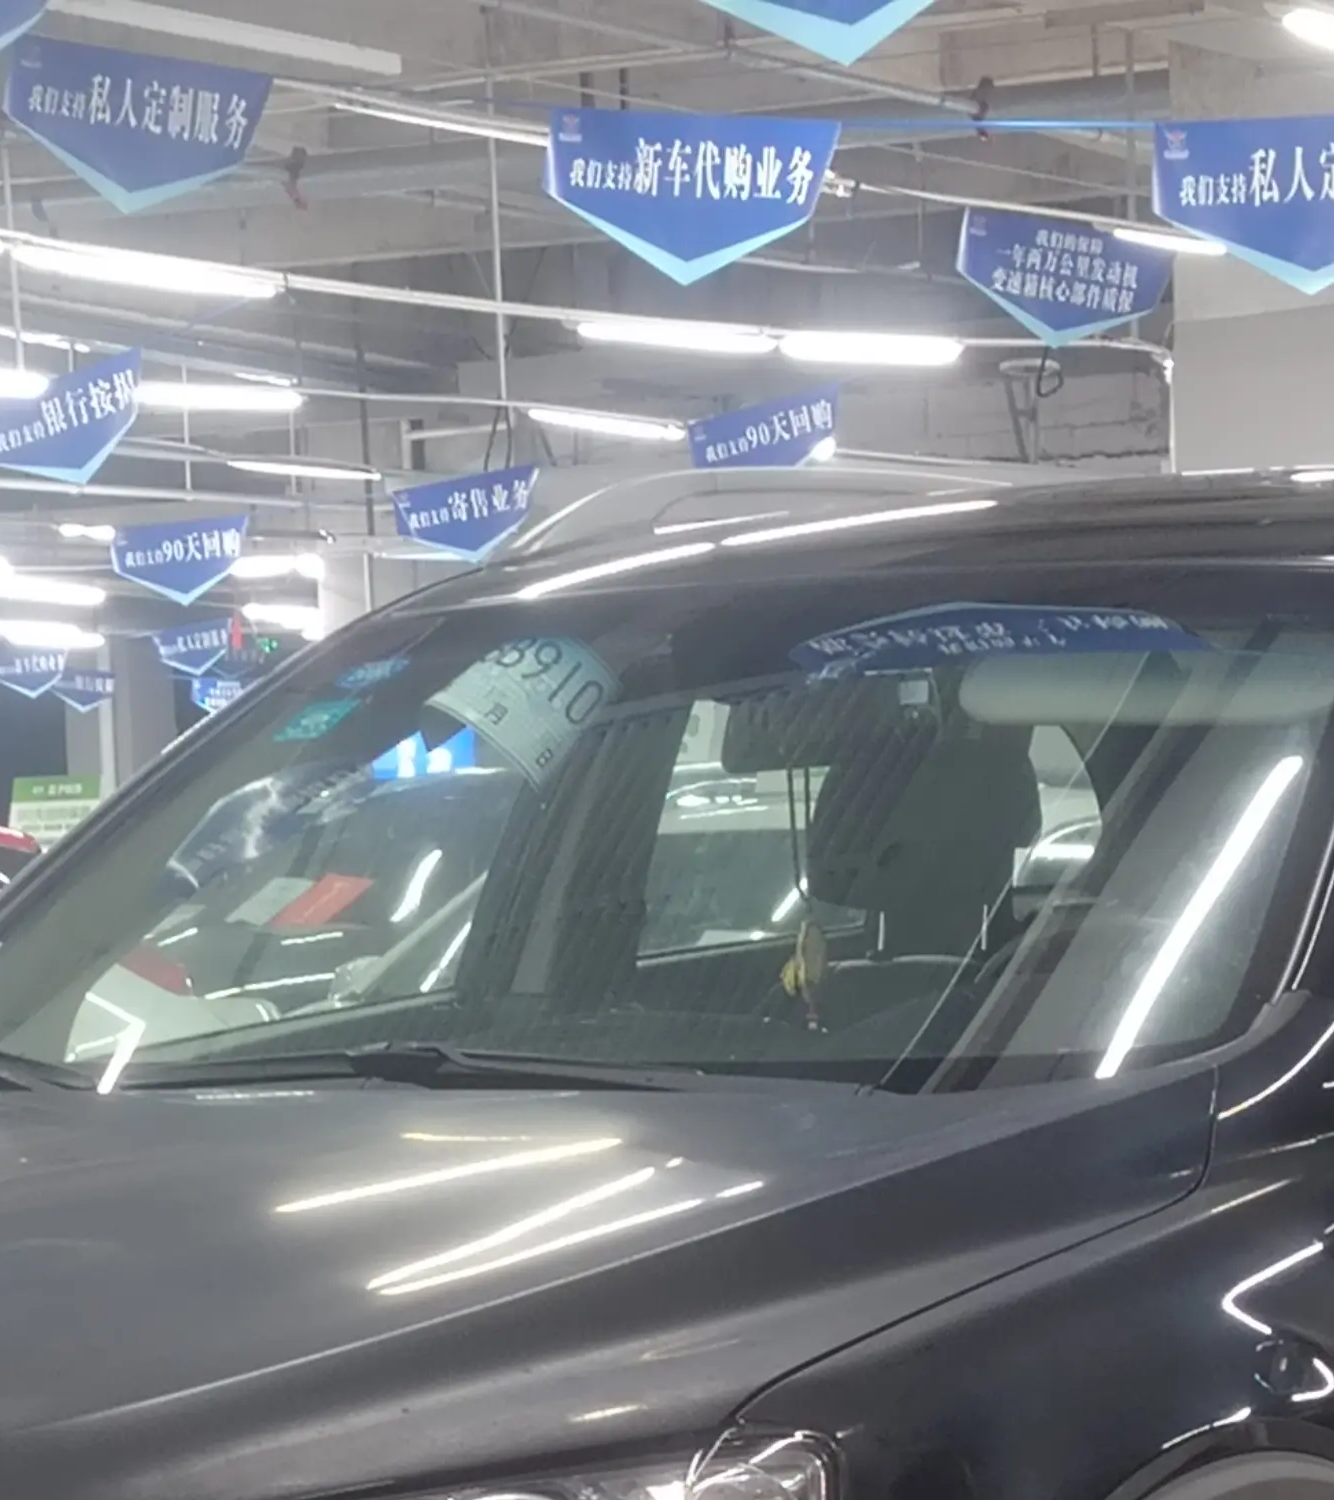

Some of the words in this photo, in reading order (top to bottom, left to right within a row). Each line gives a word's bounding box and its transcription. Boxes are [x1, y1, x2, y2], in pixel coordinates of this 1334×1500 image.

[28, 74, 248, 150] 我们支持私人定制服务
[569, 138, 814, 205] 我们支持新车代购业务
[997, 243, 1139, 290] 一年两万公里发动机
[1036, 229, 1104, 253] 我们的保障
[705, 398, 833, 464] 我们支持90天回购
